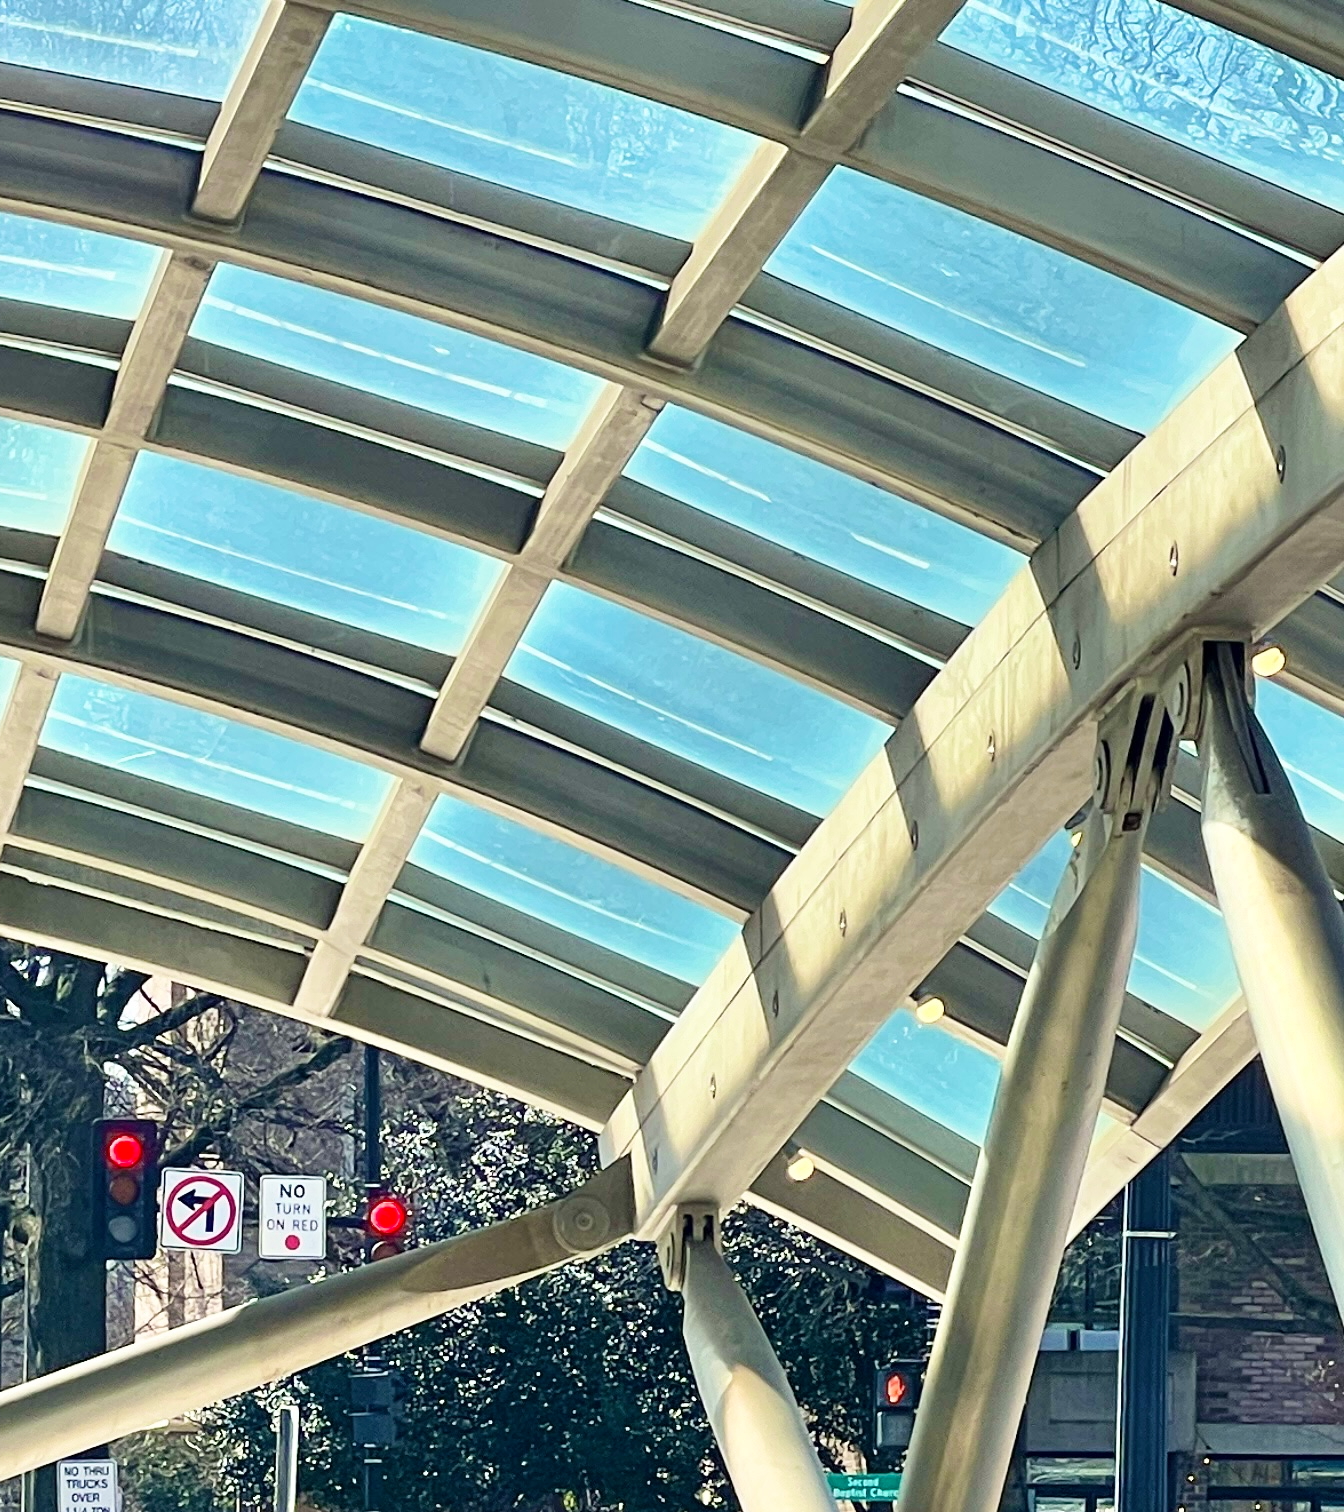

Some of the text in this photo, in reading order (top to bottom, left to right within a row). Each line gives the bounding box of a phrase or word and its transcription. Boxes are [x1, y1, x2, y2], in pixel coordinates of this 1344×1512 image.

[280, 1184, 305, 1198] NO
[276, 1202, 311, 1215] TURN
[267, 1218, 318, 1231] ON RED
[64, 1466, 110, 1476] NO THRU
[66, 1479, 108, 1489] TRUCKS
[847, 1476, 879, 1487] Second
[71, 1492, 100, 1503] OVER
[869, 1488, 899, 1498] Churc
